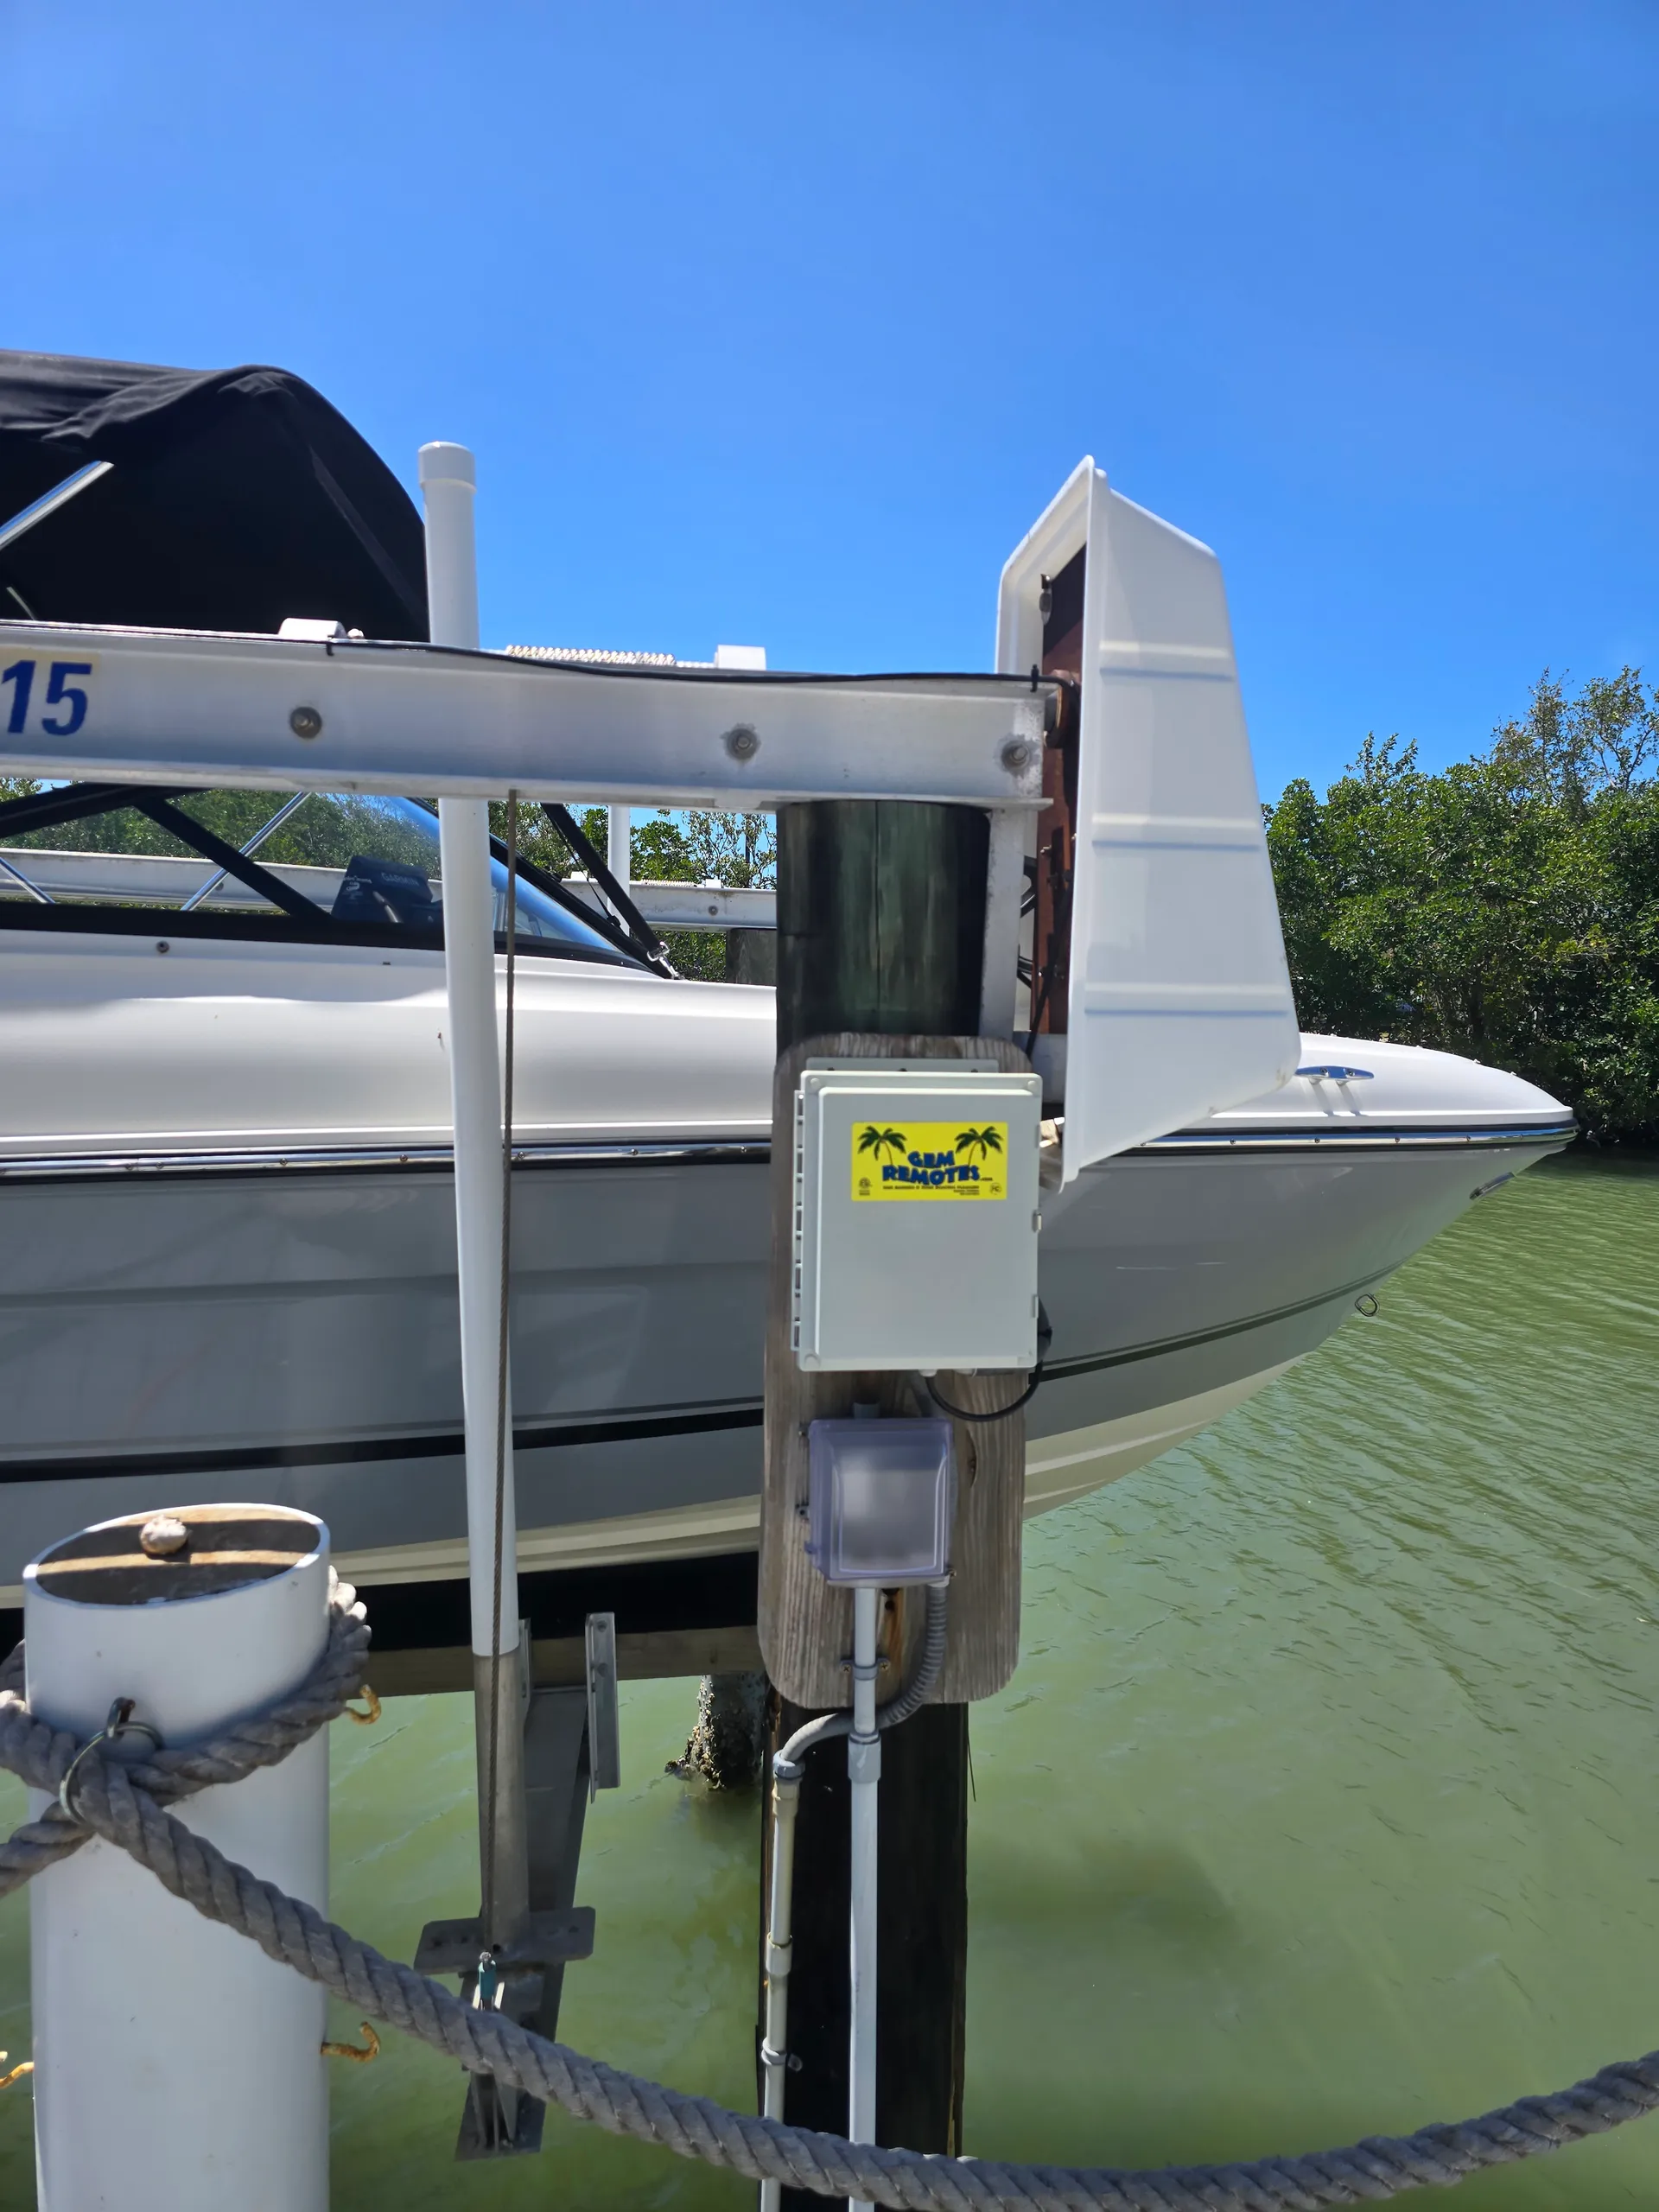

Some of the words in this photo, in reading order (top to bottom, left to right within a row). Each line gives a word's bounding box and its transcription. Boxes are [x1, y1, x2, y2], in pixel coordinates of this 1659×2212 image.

[1, 659, 92, 736] 15
[907, 1151, 956, 1168] GEM
[882, 1165, 980, 1185] REMOTES
